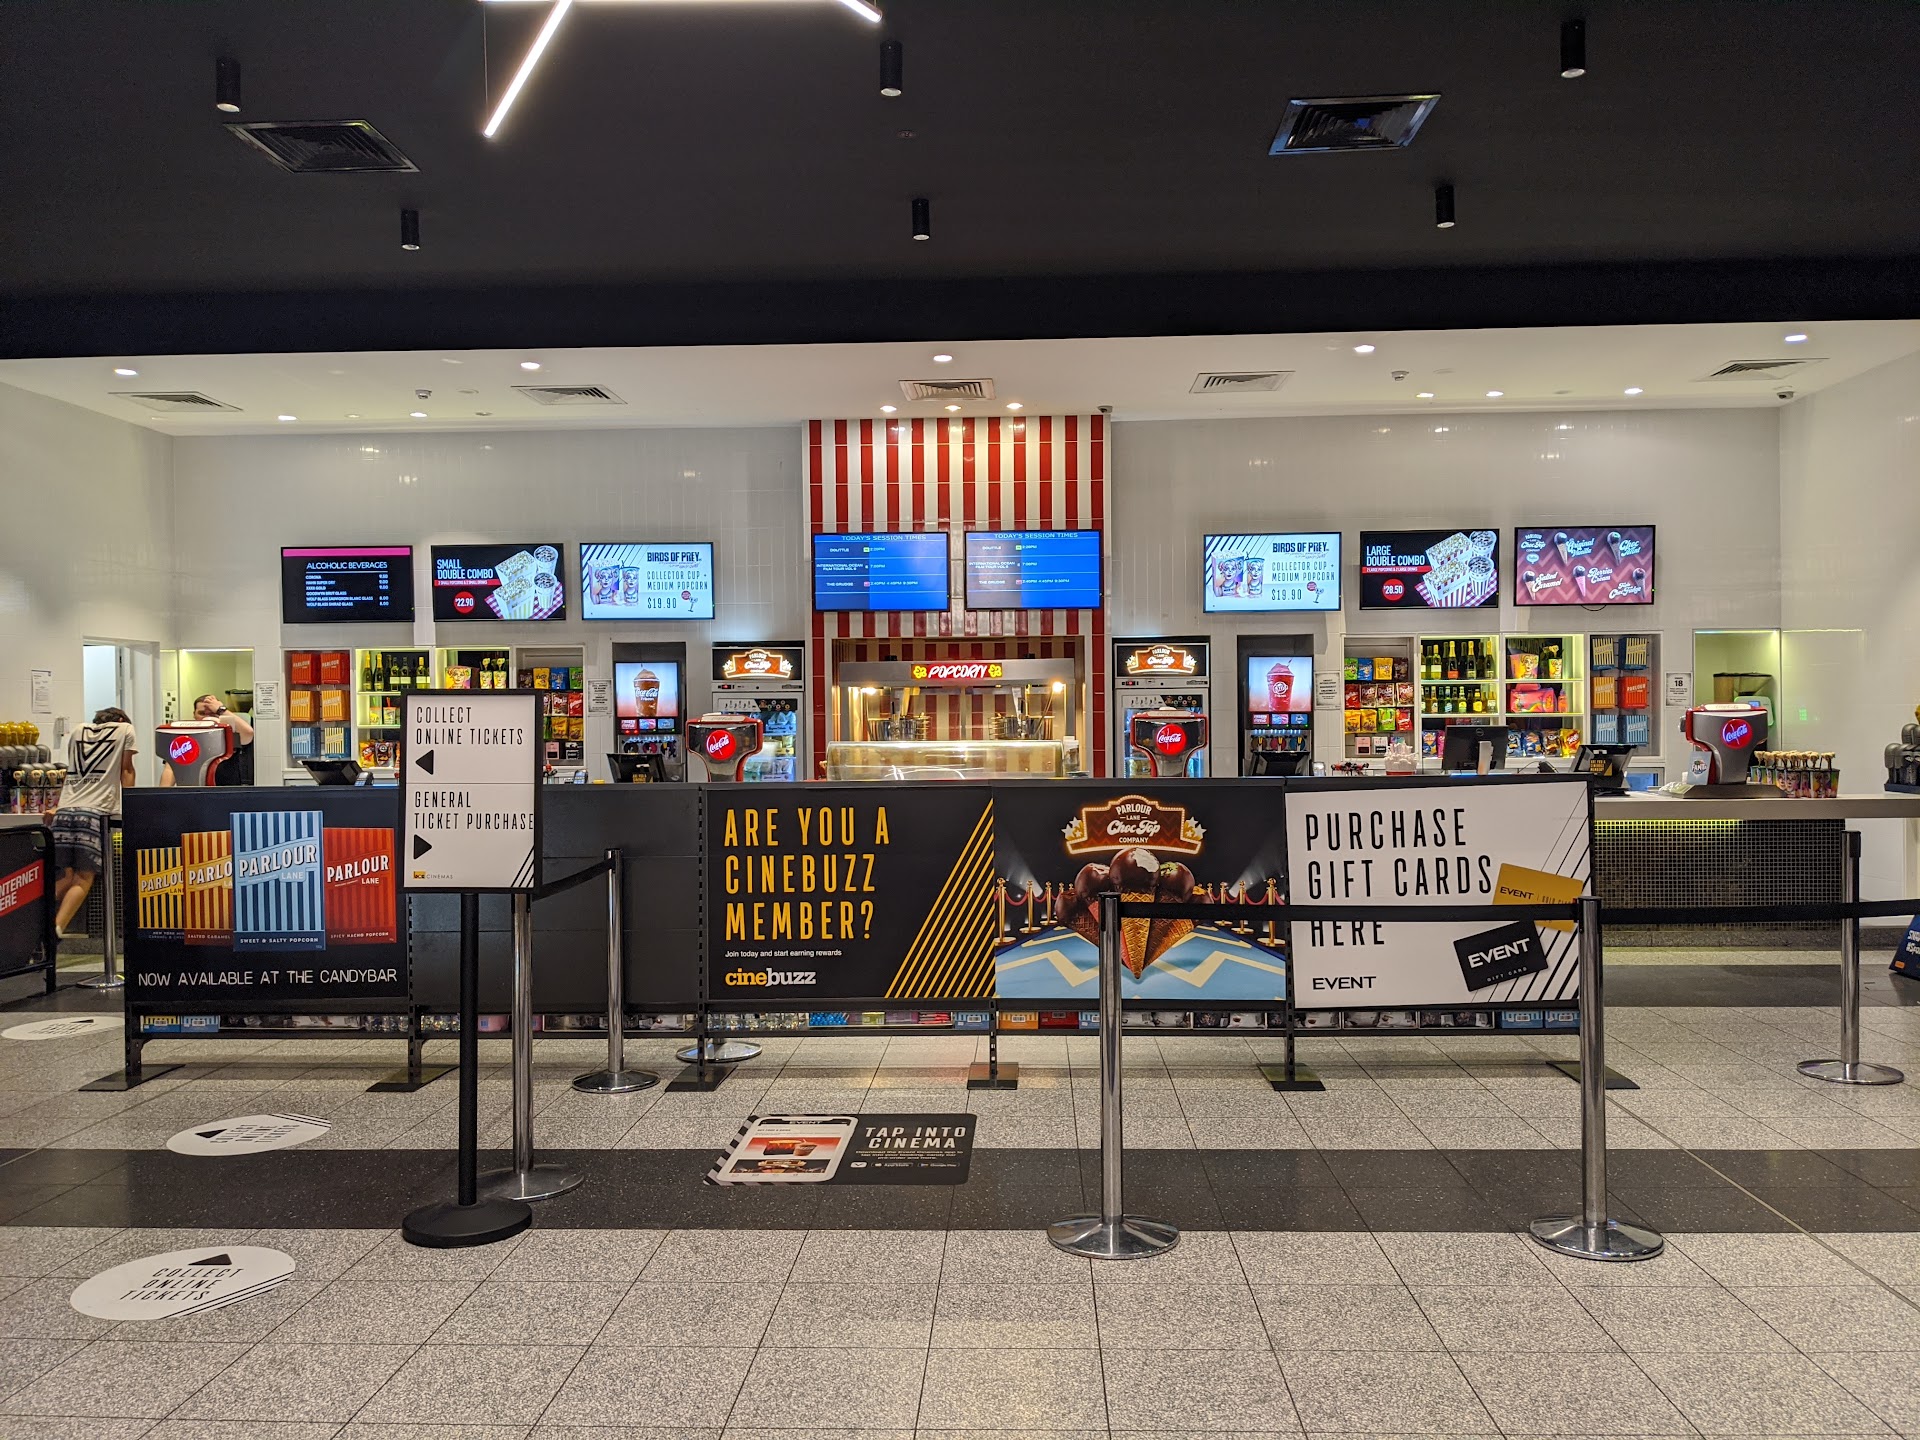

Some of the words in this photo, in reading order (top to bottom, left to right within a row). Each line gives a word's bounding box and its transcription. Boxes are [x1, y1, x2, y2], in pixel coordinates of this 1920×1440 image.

[1273, 542, 1295, 553] BIRDS
[1297, 542, 1306, 552] OF
[1308, 542, 1328, 552] PREY
[1366, 545, 1391, 556] LARGE
[647, 552, 670, 562] BIRDS
[671, 552, 680, 561] OF
[681, 552, 700, 561] PREY
[1367, 555, 1395, 566] DOUBLE
[1397, 555, 1425, 566] COMBO
[306, 562, 347, 570] ALCOHOLIC
[348, 561, 388, 569] BEVERAGES
[437, 559, 462, 569] SMALL
[1271, 562, 1311, 571] COLLECTOR
[1314, 561, 1327, 571] CUP
[437, 569, 465, 579] DOUBLE
[467, 569, 494, 579] COMBO
[646, 571, 684, 580] COLLECTOR
[687, 570, 700, 580] CUP
[1271, 572, 1300, 581] MEDIUM
[1303, 572, 1335, 581] POPCORN
[647, 581, 674, 590] MEDIUM
[677, 581, 708, 590] POPCORN
[1271, 589, 1302, 601] $19.90
[455, 598, 474, 607] $22.90
[647, 597, 677, 609] $19.90
[928, 664, 989, 679] POPCORN
[416, 706, 472, 723] COLLECT
[416, 728, 462, 745] ONLINE
[470, 728, 524, 745] TICKETS
[414, 791, 471, 808] GENERAL
[1115, 803, 1152, 815] PARLOUR
[414, 812, 459, 830] TICKET
[466, 813, 534, 830] PURCHASE
[724, 808, 779, 847] ARE
[797, 806, 855, 846] YOU
[875, 806, 890, 845] A
[1107, 820, 1136, 836] Choc
[1136, 820, 1161, 837] Top
[1305, 808, 1467, 852] PURCHASE
[238, 844, 318, 878] PARLOUR
[327, 854, 390, 883] PARLOUR
[725, 854, 875, 894] CINEBUZZ
[281, 872, 304, 880] LANE
[361, 877, 380, 885] LANE
[1308, 859, 1373, 900] GIFT
[1394, 855, 1492, 897] CARDS
[1500, 886, 1534, 900] EVENT
[725, 900, 874, 941] MEMBER?
[1310, 920, 1385, 947] HERE
[725, 950, 740, 958] Join
[740, 950, 759, 958] today
[789, 949, 815, 958] earning
[1467, 937, 1531, 969] EVENT
[138, 972, 172, 987] NOW
[178, 970, 254, 986] AVAILABLE
[260, 970, 280, 985] AT
[286, 969, 314, 984] THE
[319, 968, 398, 984] CANDYBAR
[725, 967, 817, 987] cinebuzz
[1486, 973, 1505, 982] GIFT
[1507, 966, 1528, 976] CARD
[1312, 976, 1377, 991] EVENT
[209, 1124, 258, 1143] COLLECT
[235, 1126, 278, 1142] ONLINE
[254, 1124, 300, 1143] TICKETS
[865, 1127, 905, 1138] TAP
[915, 1126, 966, 1138] INTO
[868, 1137, 956, 1149] CINEMA
[152, 1268, 244, 1278] COLLECT
[141, 1279, 221, 1289] ONLINE
[119, 1290, 211, 1301] TICKETS
